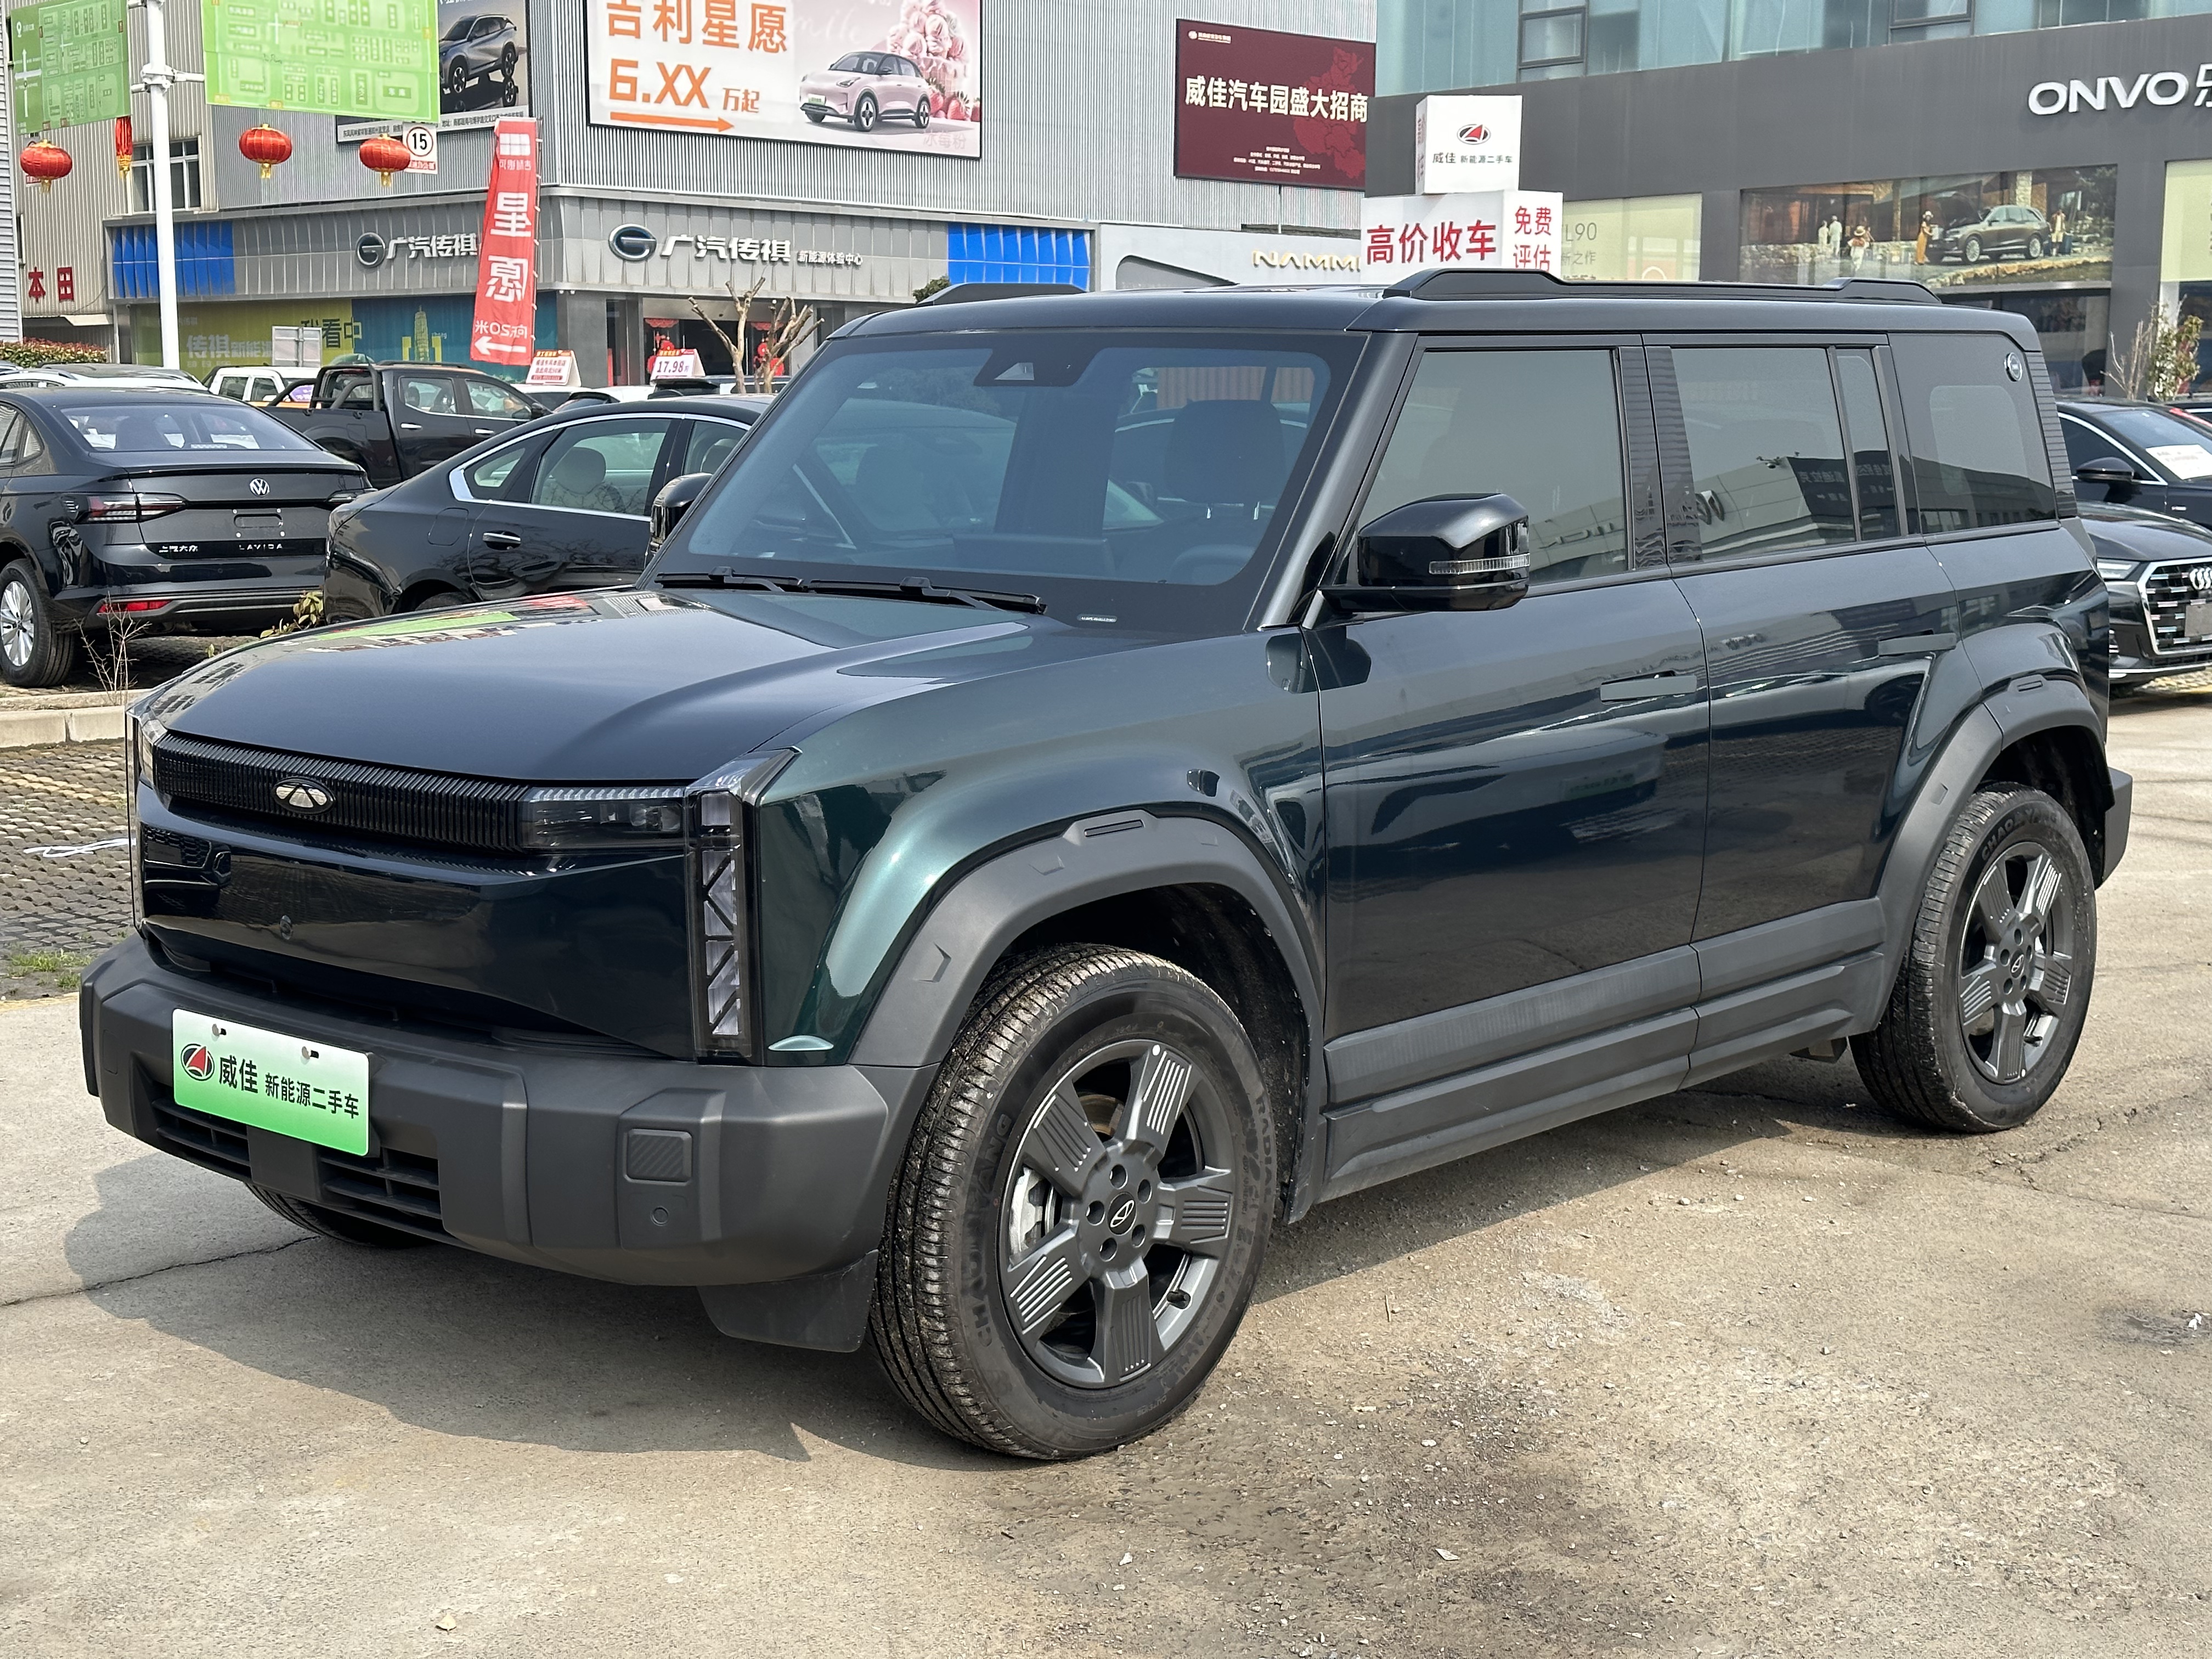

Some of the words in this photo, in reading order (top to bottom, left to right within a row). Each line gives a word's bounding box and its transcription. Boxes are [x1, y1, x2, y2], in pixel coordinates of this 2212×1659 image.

[605, 0, 787, 53] 吉利星愿
[610, 58, 712, 109] 6.XX
[723, 88, 760, 113] 万起
[1185, 75, 1369, 123] 威佳汽车园盛大招商
[2028, 71, 2189, 115] ONVO
[413, 133, 427, 150] 15
[1432, 152, 1457, 163] 威佳
[1460, 155, 1513, 164] 新能源二手车
[1514, 206, 1552, 236] 免费
[386, 233, 478, 259] 广汽传祺
[661, 234, 792, 263] 广汽传祺
[797, 250, 864, 267] 新能源体验中心
[1366, 219, 1497, 265] 高价收车
[1513, 244, 1552, 271] 评估
[29, 267, 74, 302] 本田
[301, 317, 362, 349] 看中
[218, 1054, 258, 1094] 威佳
[265, 1072, 359, 1119] 新能源二手车
